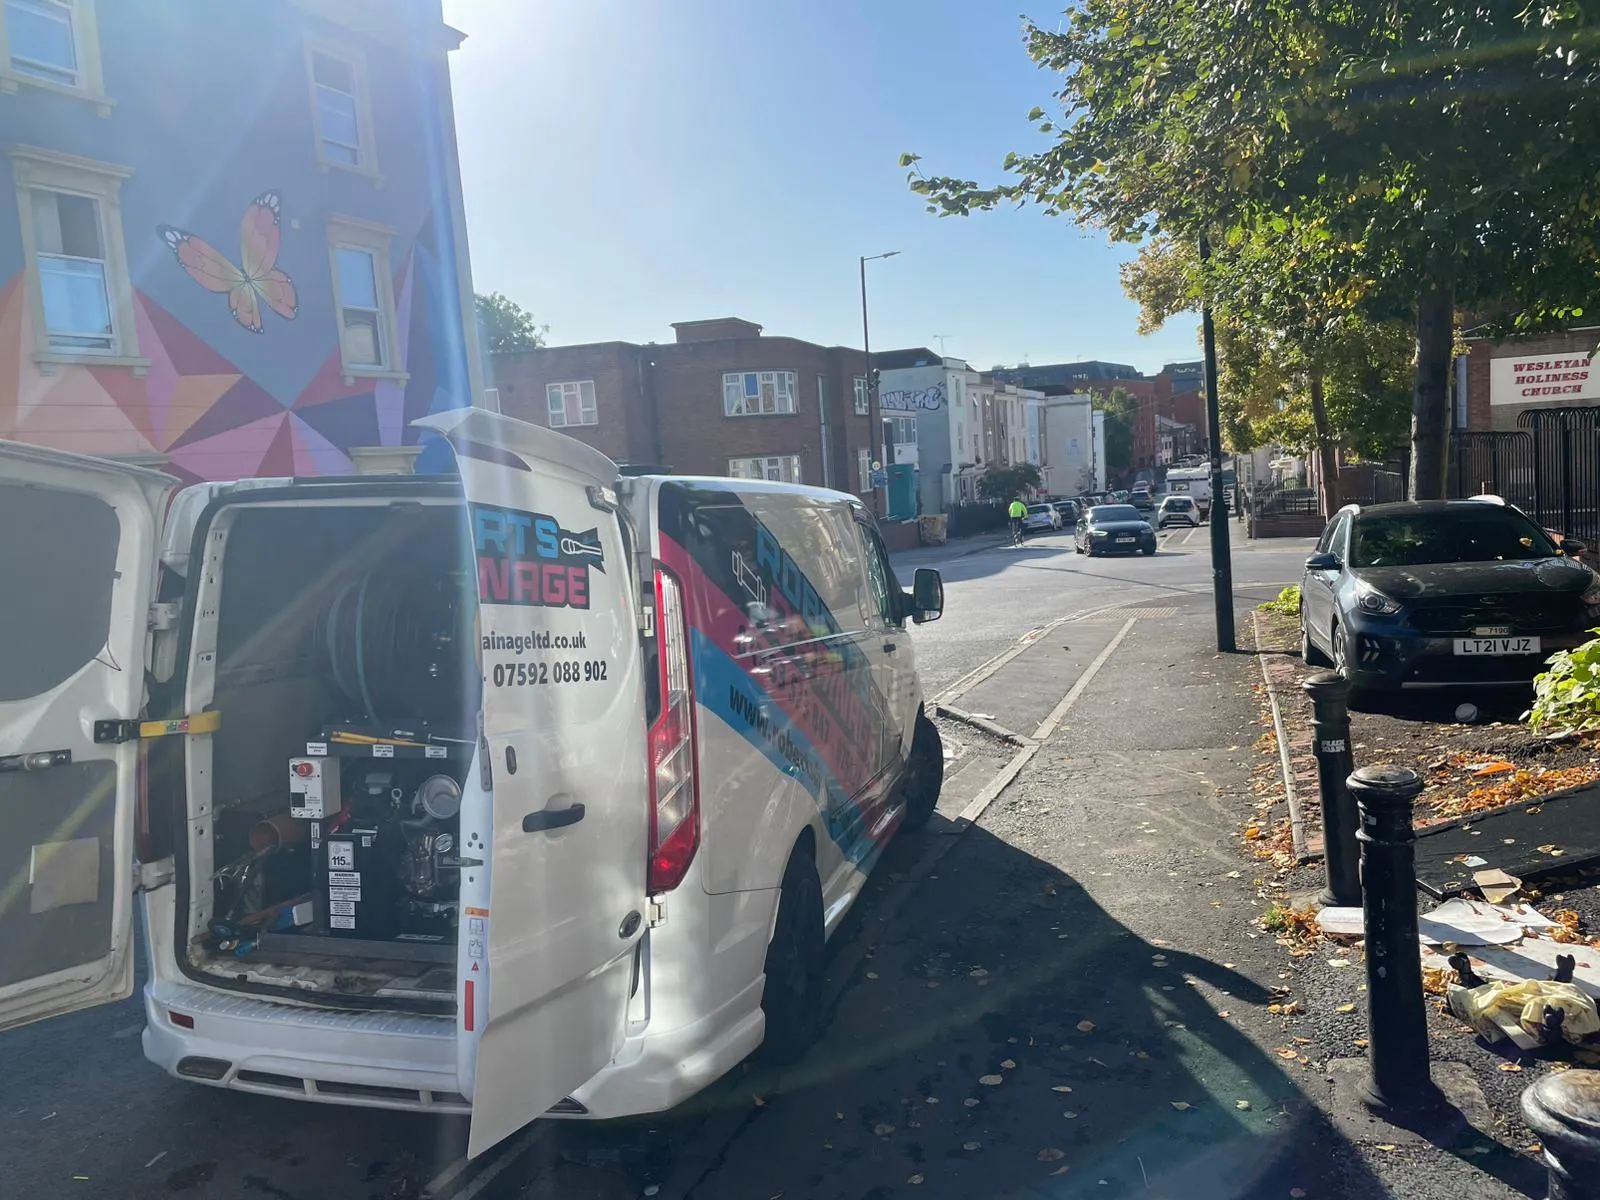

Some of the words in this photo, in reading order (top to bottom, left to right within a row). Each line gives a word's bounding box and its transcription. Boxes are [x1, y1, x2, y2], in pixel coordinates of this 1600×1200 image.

[1513, 358, 1592, 372] WESLEYAN
[1515, 371, 1589, 385] HOLINESS
[1522, 384, 1583, 397] CHURCH
[474, 508, 560, 559] RTS
[479, 556, 587, 605] NAGE
[482, 631, 587, 655] ainageltd.co.uk
[1463, 640, 1497, 653] LT21
[1501, 639, 1531, 652] VJZ
[493, 661, 549, 688] 07592
[553, 661, 581, 684] 088
[584, 660, 608, 682] 902
[332, 856, 346, 866] 115
